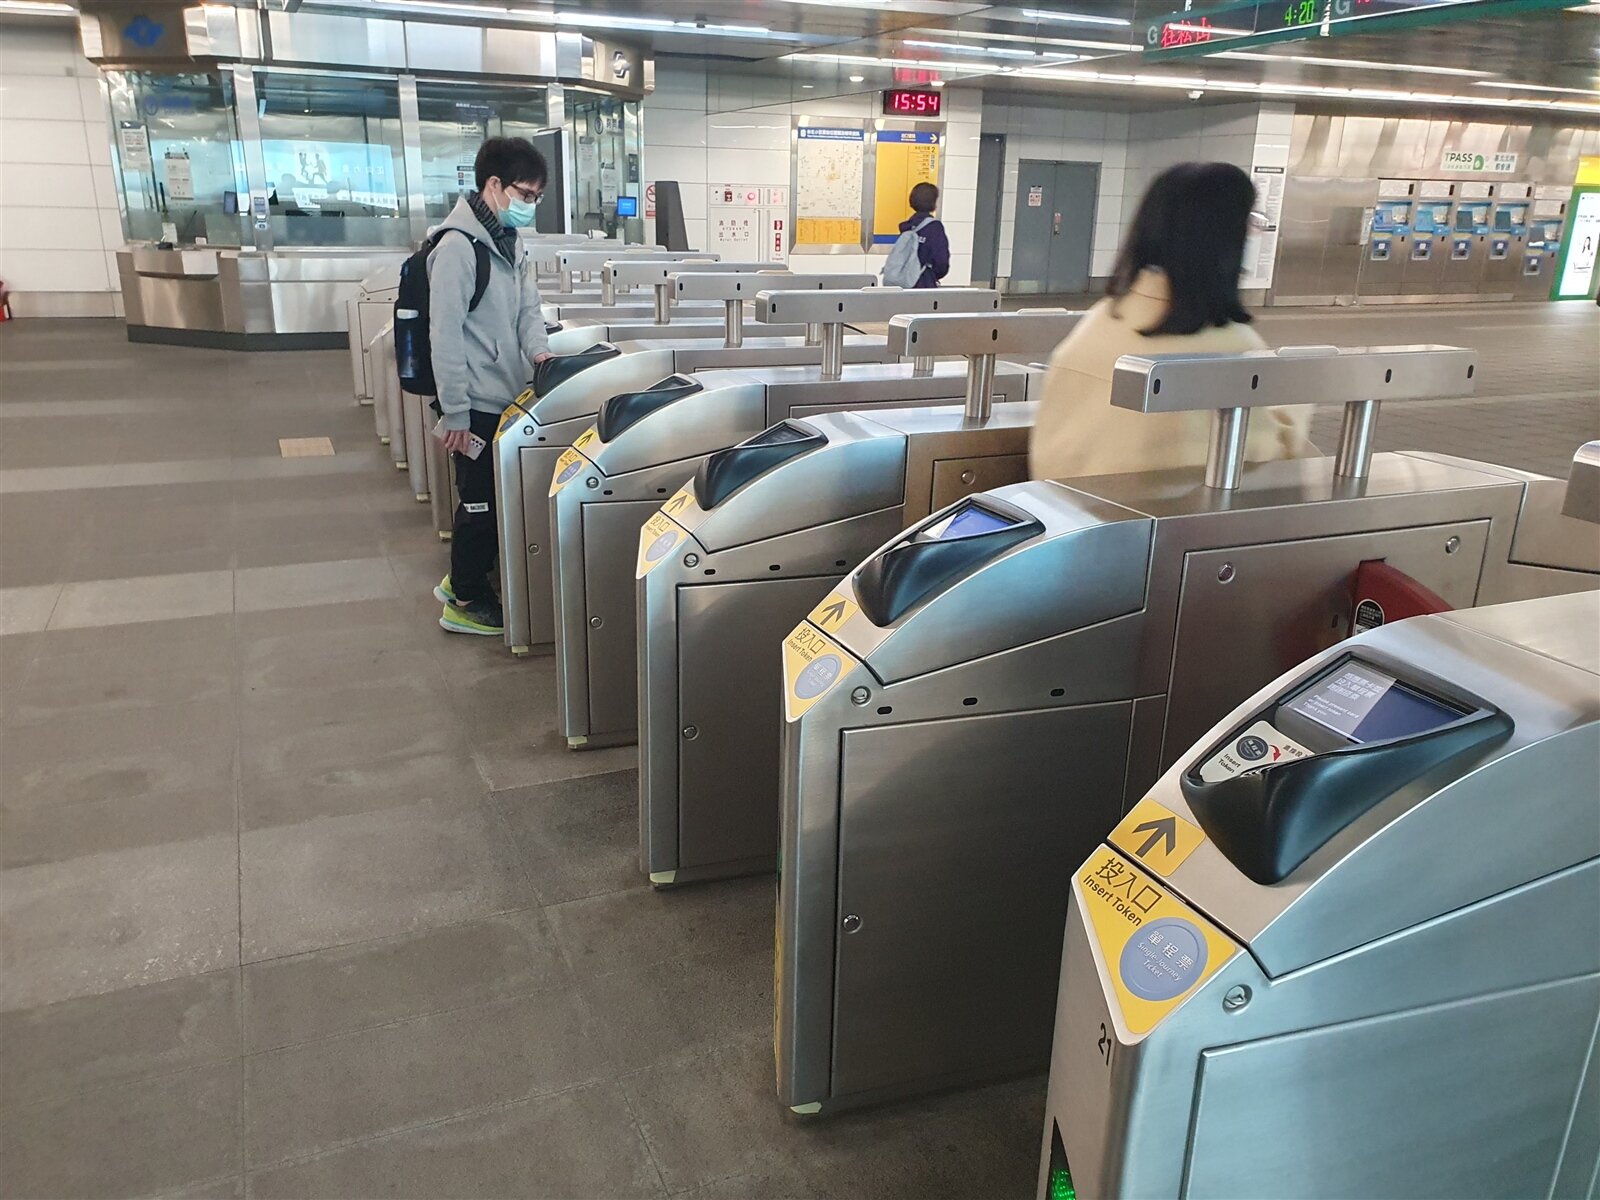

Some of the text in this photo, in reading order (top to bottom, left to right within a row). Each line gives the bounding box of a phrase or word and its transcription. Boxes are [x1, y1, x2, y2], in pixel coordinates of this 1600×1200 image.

[1284, 0, 1314, 26] 4:20
[1148, 26, 1158, 44] G
[1160, 16, 1212, 47] 往松山
[894, 94, 938, 110] 15:54
[1444, 153, 1473, 162] TPASS
[787, 639, 813, 662] Insert Token
[795, 627, 826, 654] 投入口
[1218, 758, 1235, 773] Token
[1224, 753, 1241, 768] Insert
[1095, 857, 1162, 914] 投入口
[1083, 874, 1142, 926] Insert Token
[1148, 930, 1193, 970] 單程票
[1143, 960, 1163, 978] Ticket
[1098, 1022, 1112, 1066] 21
